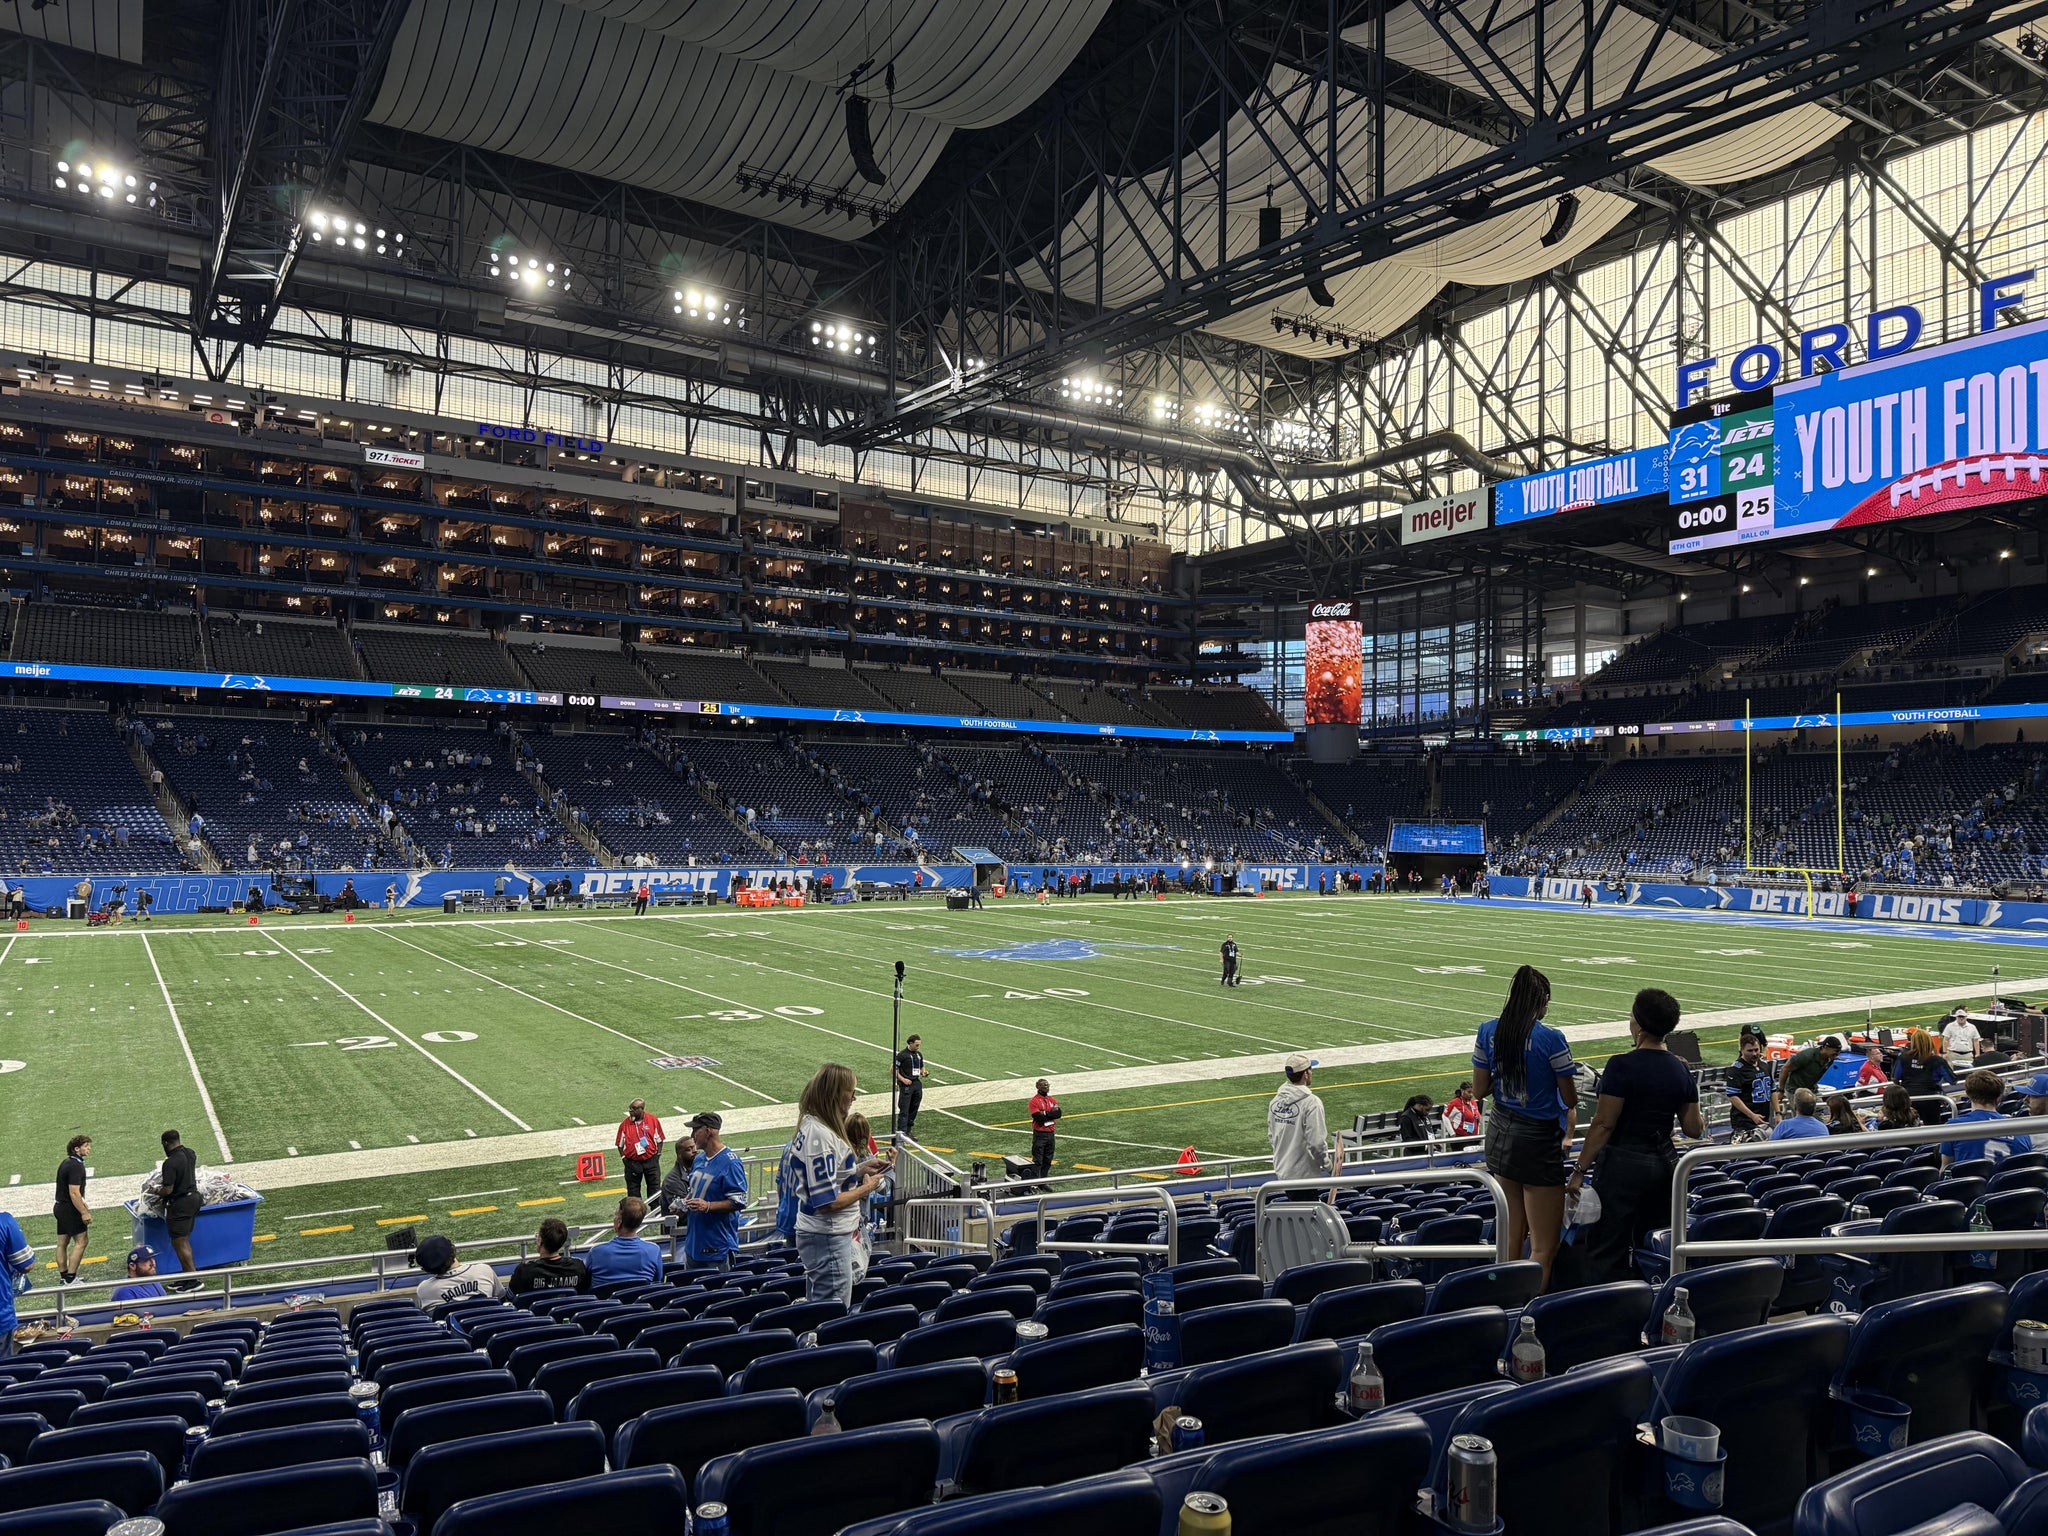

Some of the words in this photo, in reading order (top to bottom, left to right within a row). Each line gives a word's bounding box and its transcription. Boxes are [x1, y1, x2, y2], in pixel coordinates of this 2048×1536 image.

[1677, 304, 1924, 410] FORD
[1980, 265, 2038, 333] F
[1710, 403, 1731, 416] Lite
[479, 423, 536, 442] FORD
[545, 432, 603, 453] FIELD
[1720, 420, 1774, 446] JETS
[1795, 386, 1927, 494] YOUTH
[369, 451, 389, 461] 97.1
[391, 456, 420, 466] TICKET
[1728, 453, 1765, 482] 24
[109, 470, 134, 478] CALVIN
[135, 473, 165, 482] JOHNSON
[1680, 464, 1708, 491] 31
[1521, 471, 1565, 515] YOUTH
[1569, 457, 1638, 503] FOOTBALL
[1741, 497, 1770, 519] 25
[1412, 499, 1477, 533] meijer
[1678, 504, 1727, 529] 0:00
[106, 519, 130, 527] LOMAS
[1741, 531, 1758, 540] BALL
[1759, 529, 1770, 537] ON
[1671, 542, 1685, 551] 4TH
[1686, 540, 1701, 550] QTR
[104, 569, 128, 577] CHRIS
[130, 571, 168, 580] SPIELMAN
[302, 586, 326, 594] ROBERT
[15, 664, 51, 677] meijer
[434, 687, 453, 699] 24
[507, 691, 522, 703] 31
[549, 695, 558, 704] 4
[568, 695, 595, 706] 0:00
[703, 703, 717, 712] 25
[1892, 711, 1925, 721] YOUTH
[1927, 709, 1981, 720] FOOTBALL
[960, 719, 983, 727] YOUTH
[983, 720, 1017, 729] FOOTBALL
[1618, 725, 1639, 735] 0:00
[1526, 730, 1538, 740] 24
[1571, 728, 1582, 738] 31
[1604, 727, 1610, 735] 4
[584, 871, 718, 898] DETROIT
[1873, 894, 1963, 923] LIONS
[1004, 987, 1090, 1000] 40
[707, 1005, 825, 1021] 30
[336, 1030, 479, 1051] 20
[1771, 1050, 1781, 1060] G
[581, 1156, 603, 1178] 20
[812, 1154, 835, 1182] 20
[533, 1277, 546, 1289] BIG
[1148, 1326, 1172, 1344] Roar
[1514, 1356, 1544, 1374] Coke
[1352, 1383, 1384, 1401] Coke
